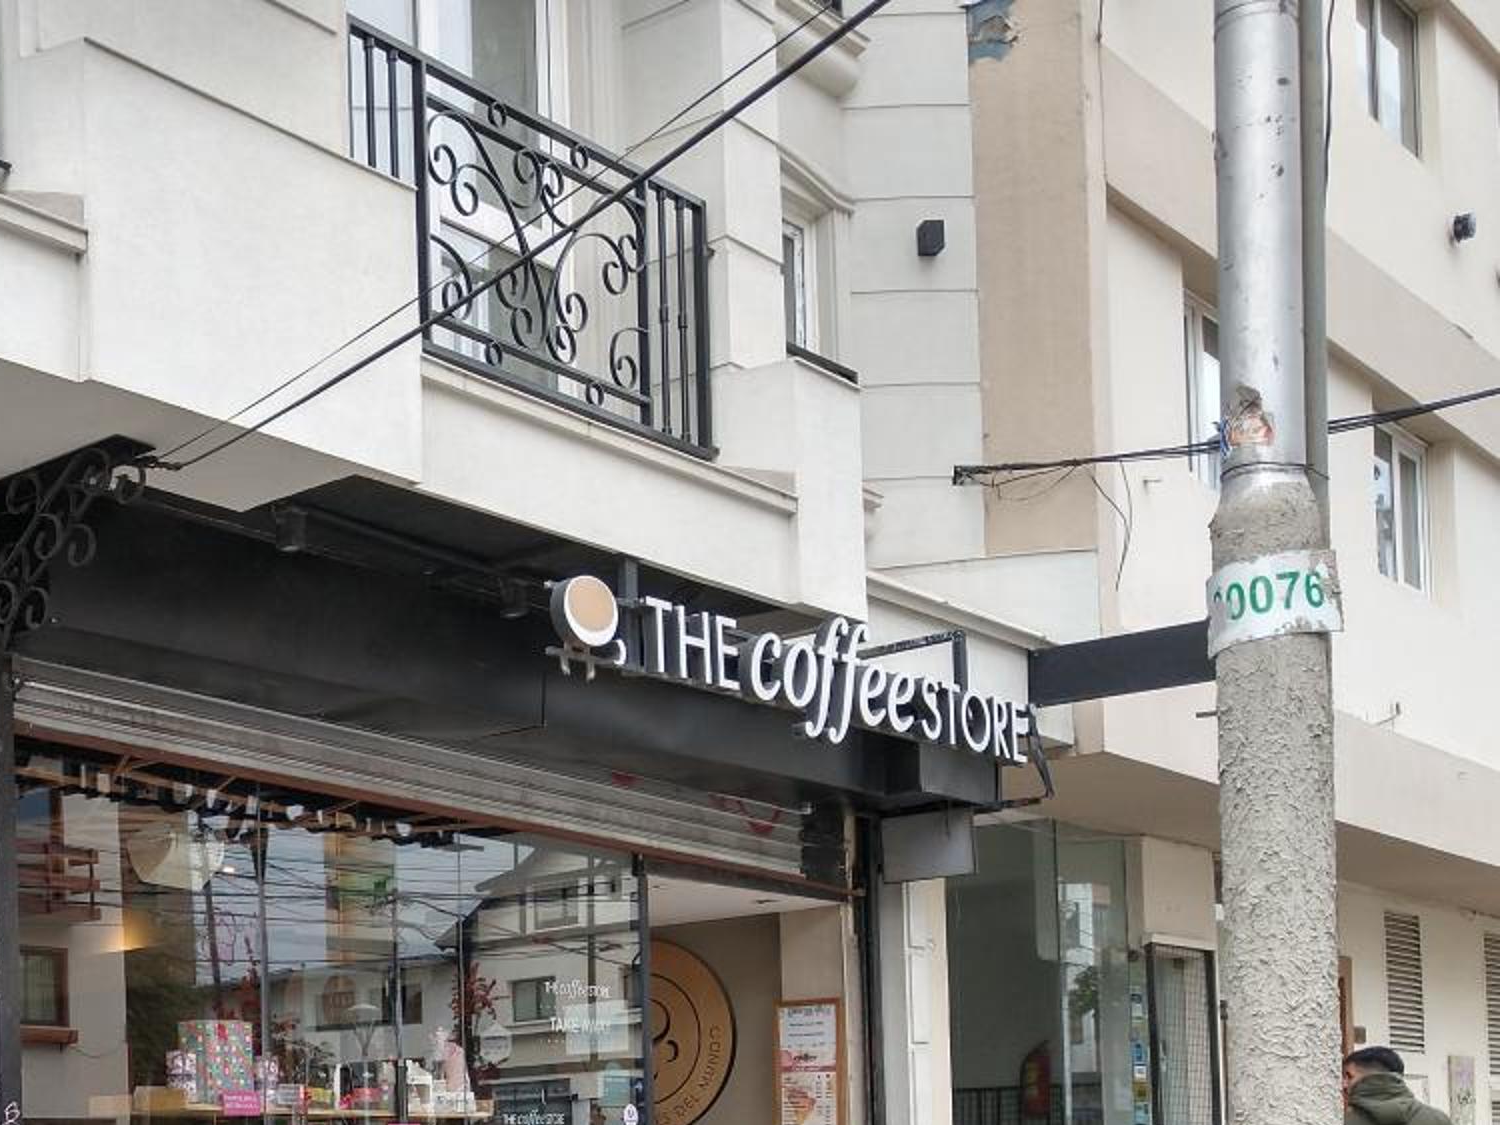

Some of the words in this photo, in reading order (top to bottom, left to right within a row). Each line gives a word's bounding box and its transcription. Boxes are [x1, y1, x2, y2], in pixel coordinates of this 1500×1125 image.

[645, 595, 742, 691] THE
[750, 616, 914, 745] coffee
[921, 675, 1031, 764] STORE
